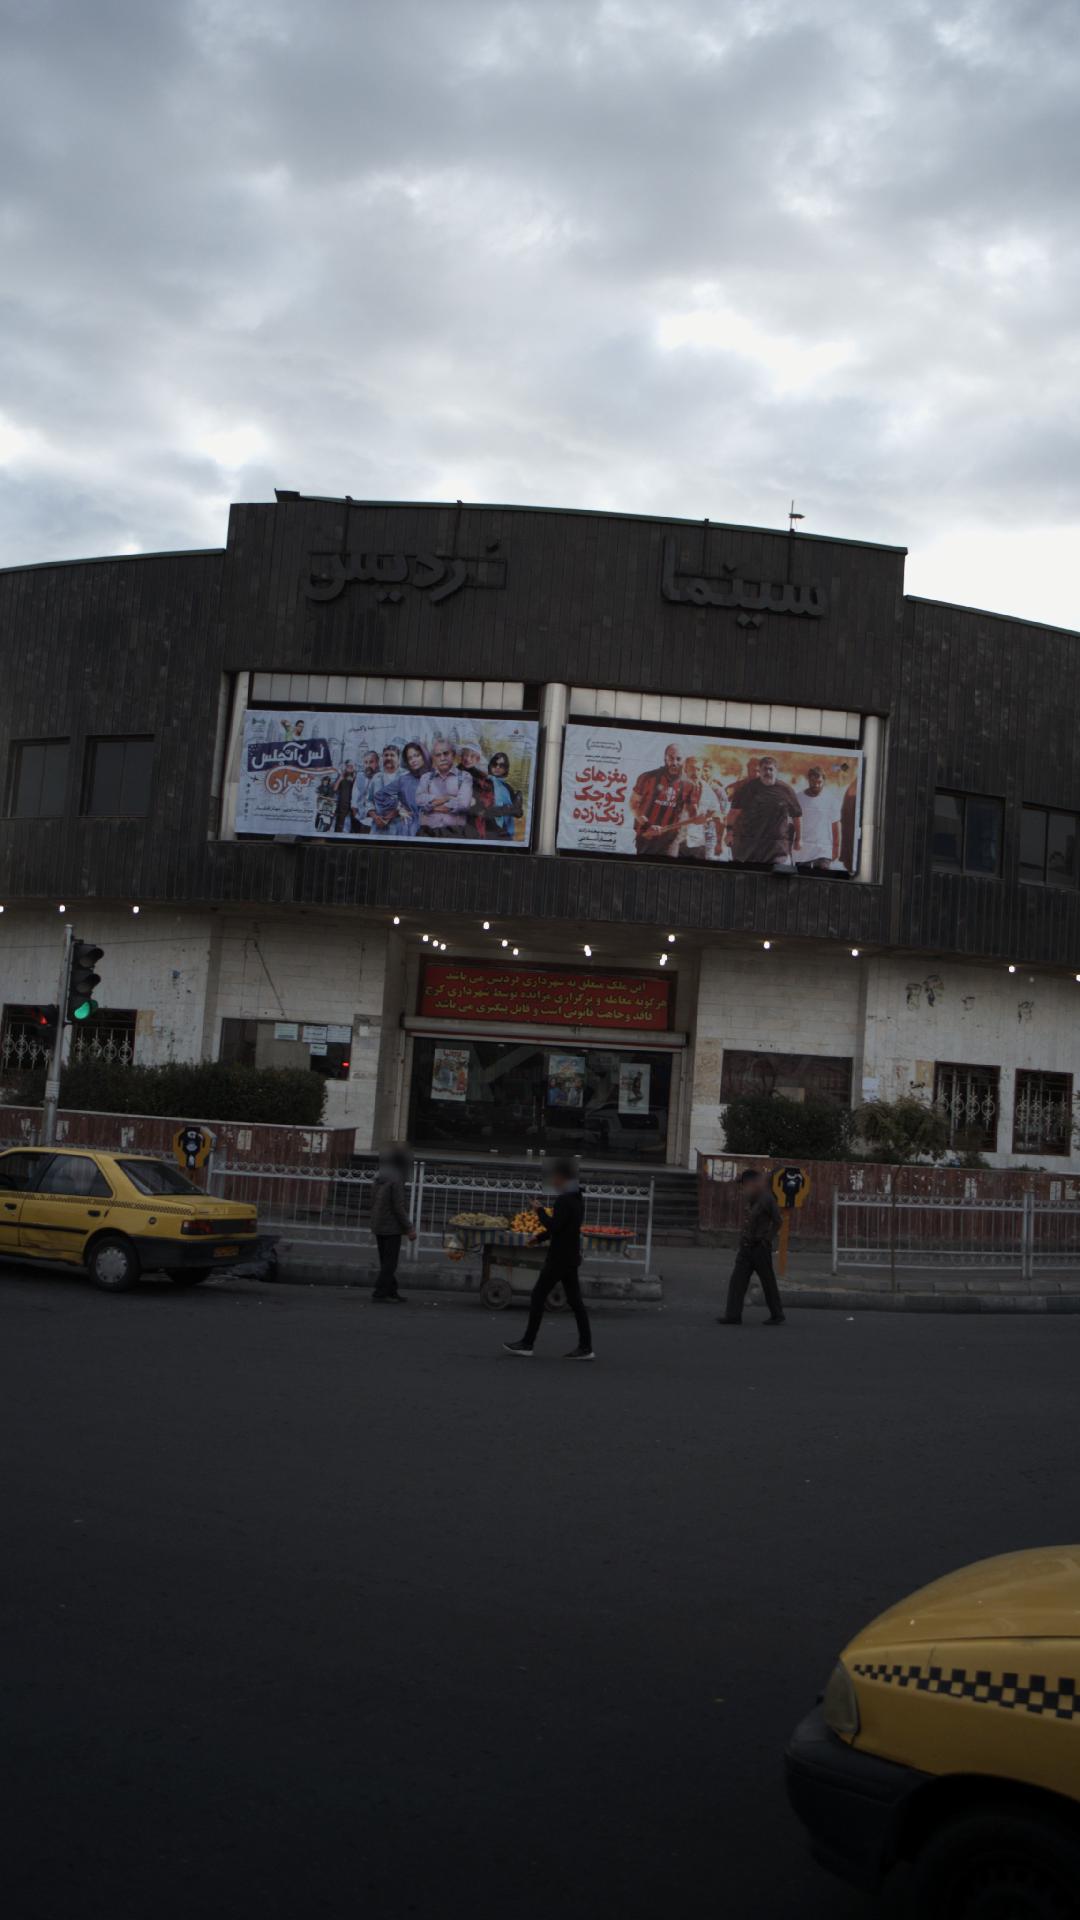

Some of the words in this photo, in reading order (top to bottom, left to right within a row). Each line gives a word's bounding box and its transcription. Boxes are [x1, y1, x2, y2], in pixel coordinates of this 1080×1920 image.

[303, 543, 500, 605] ردیس
[661, 535, 828, 628] سینما
[252, 742, 307, 769] آنجلس
[298, 743, 325, 767] لس
[265, 766, 326, 794] تهران
[576, 766, 627, 787] مغزهای
[575, 784, 627, 808] کوچک
[486, 974, 519, 986] فردیس
[522, 974, 564, 988] شهرداری
[630, 981, 647, 993] این
[447, 985, 490, 998] شهرداری
[540, 1005, 562, 1015] است
[563, 1006, 594, 1019] قانونی
